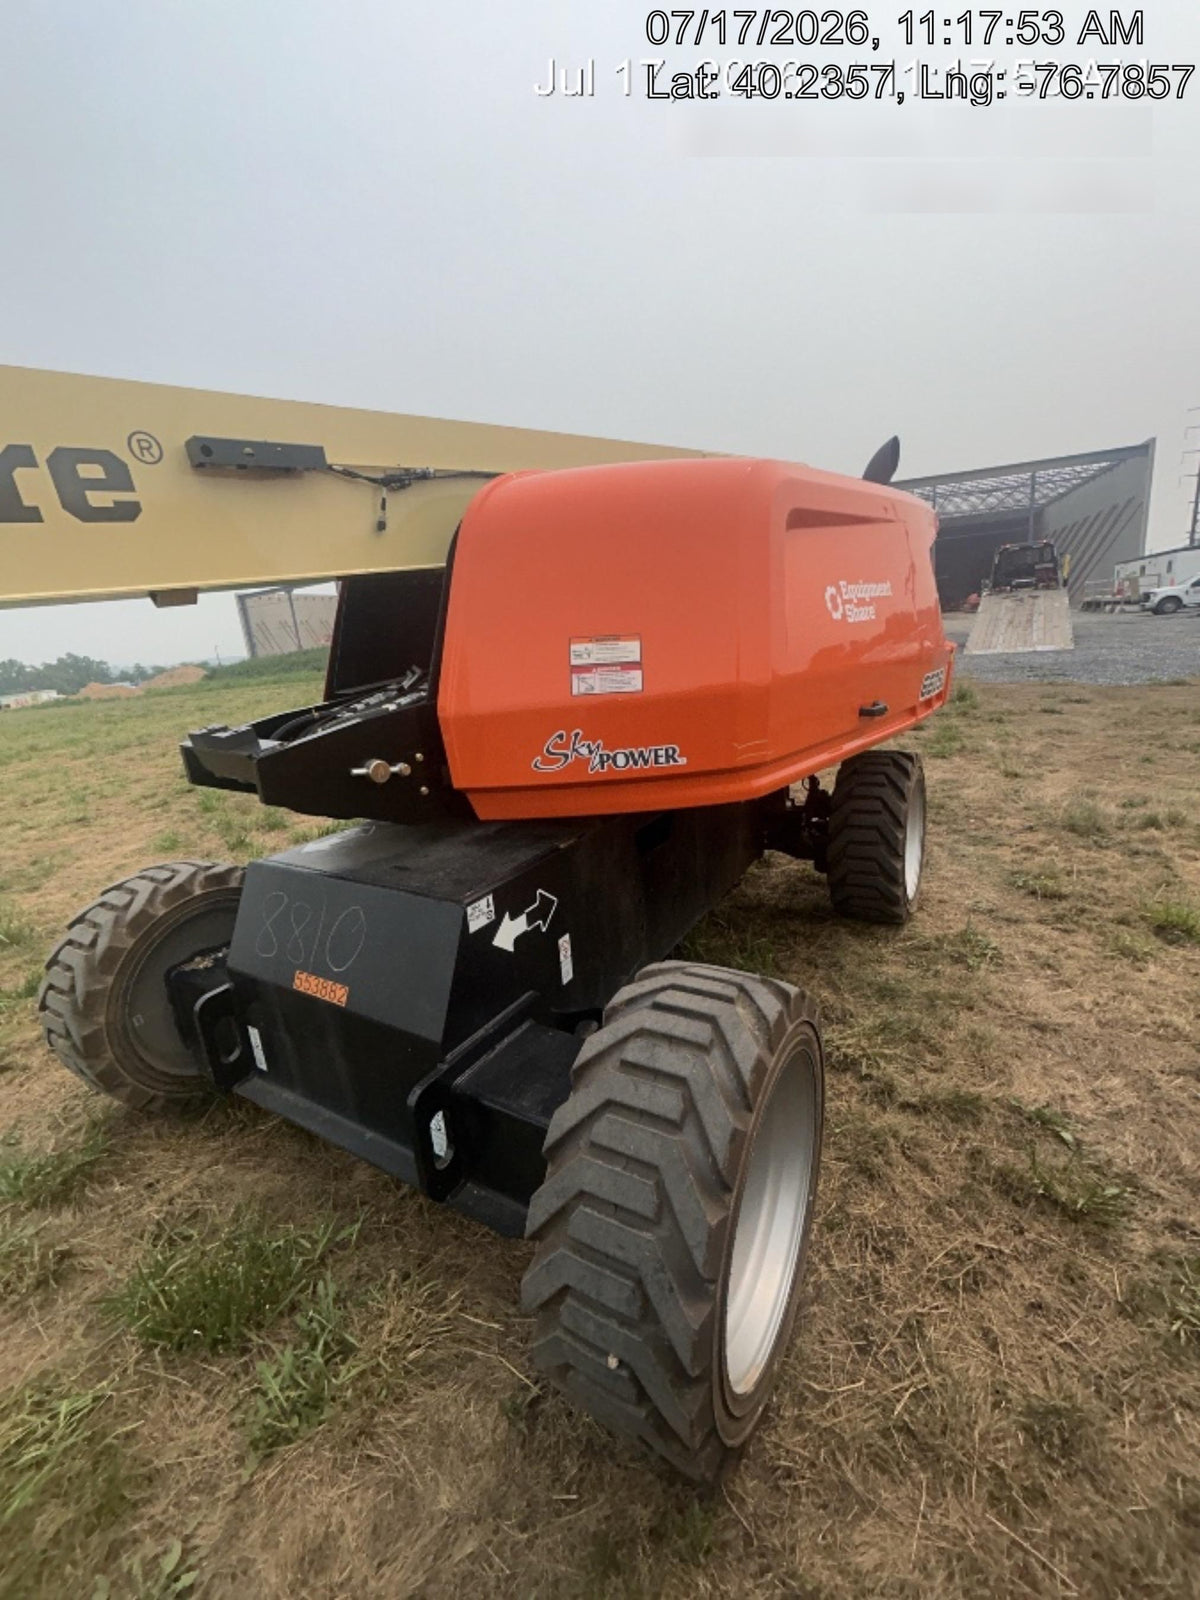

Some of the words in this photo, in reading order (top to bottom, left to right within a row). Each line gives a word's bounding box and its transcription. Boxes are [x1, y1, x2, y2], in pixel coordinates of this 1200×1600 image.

[839, 580, 893, 603] Equipment
[256, 891, 367, 972] 8810
[294, 971, 348, 1003] 553882
